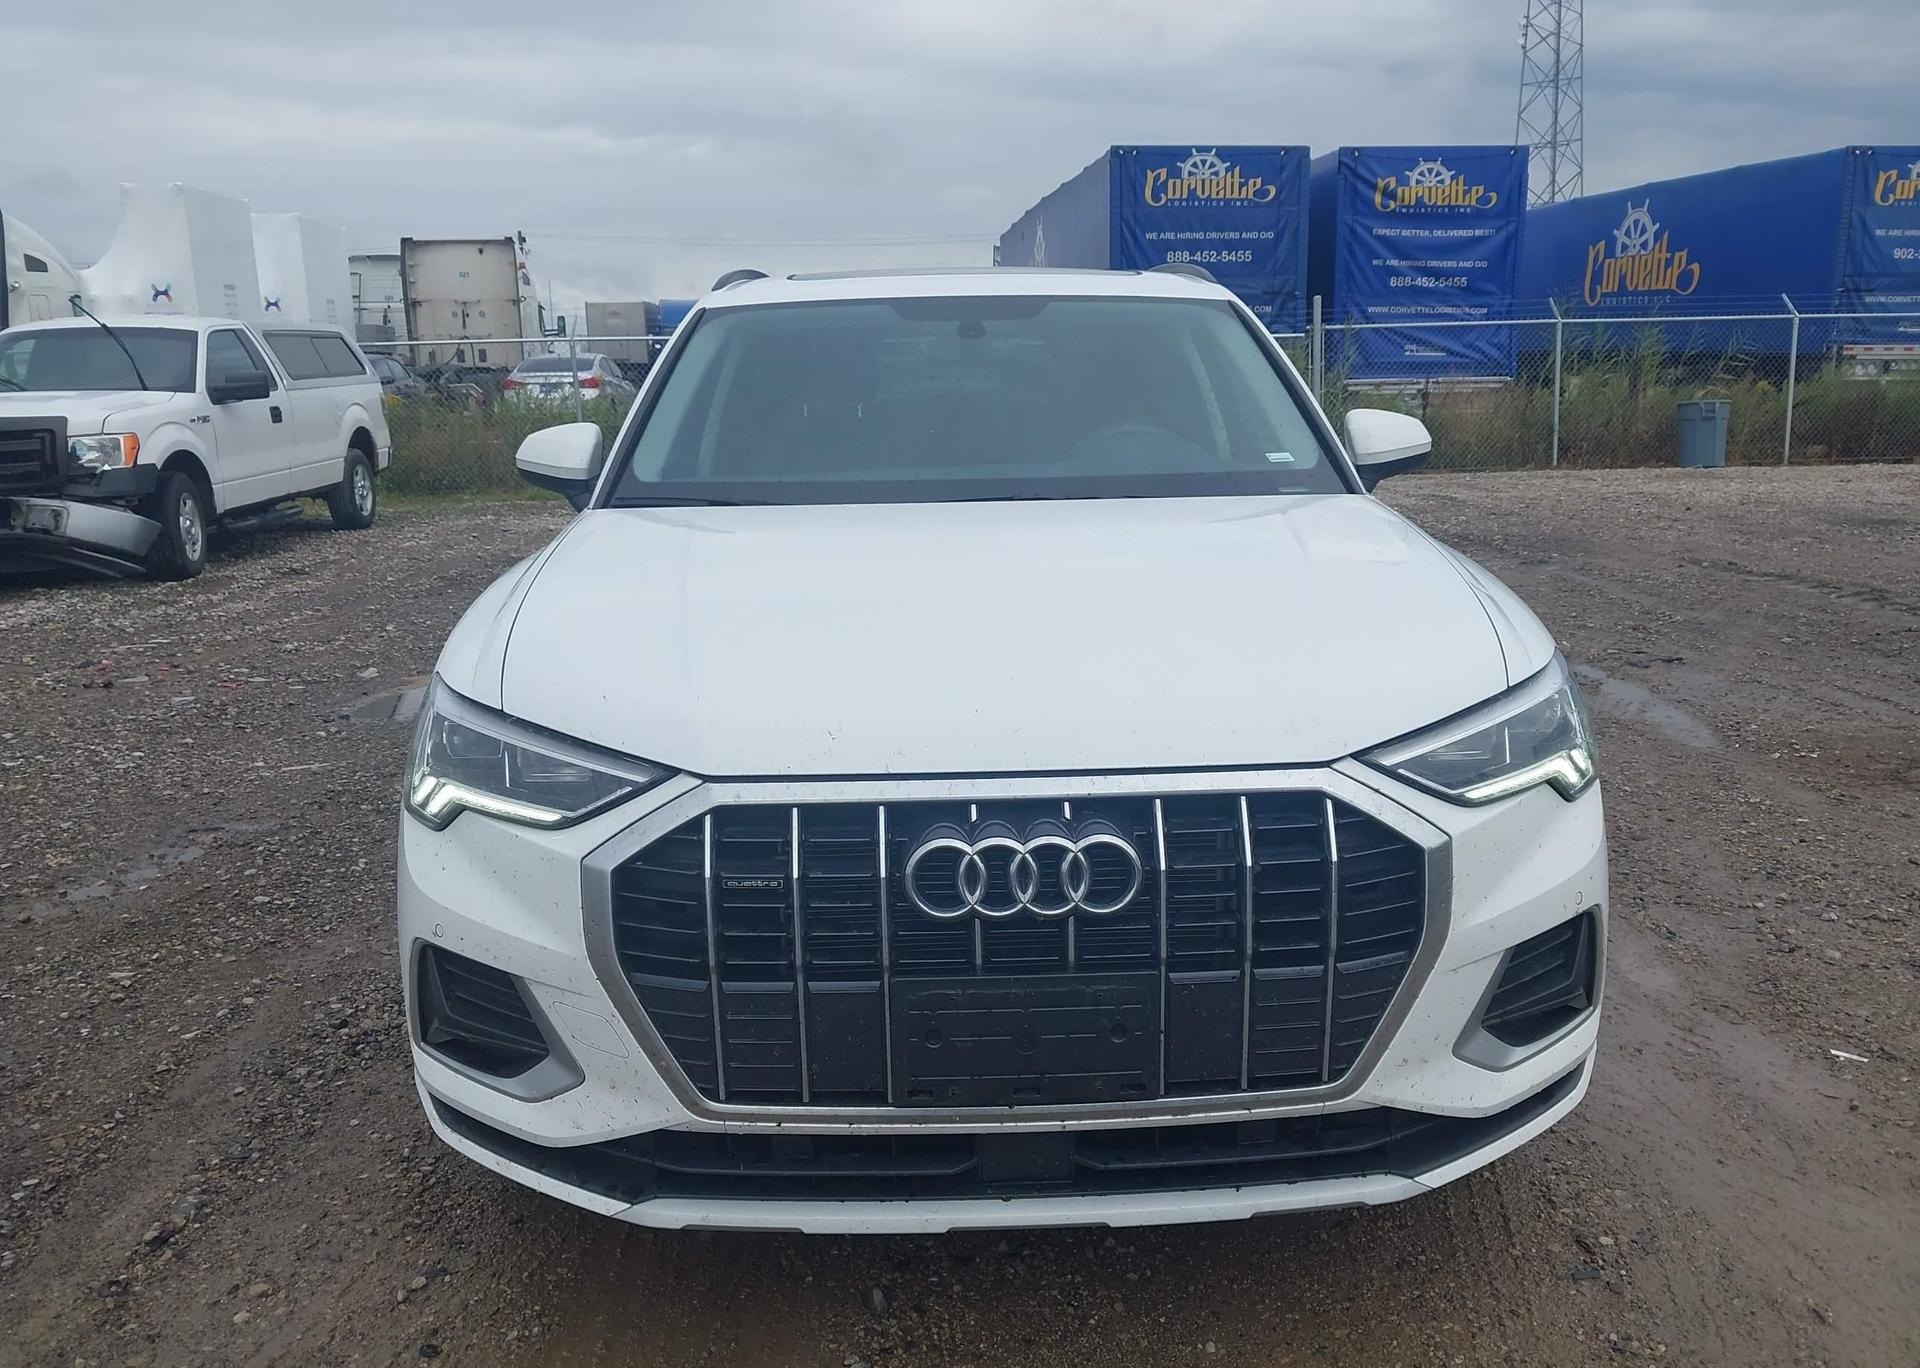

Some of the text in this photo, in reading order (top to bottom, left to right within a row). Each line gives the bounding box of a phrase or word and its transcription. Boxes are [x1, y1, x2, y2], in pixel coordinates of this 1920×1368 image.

[1144, 165, 1277, 207] Corvette
[1374, 174, 1498, 212] Corvette
[1372, 228, 1400, 236] EXPECT
[1433, 229, 1474, 237] DELIVERED
[1167, 250, 1253, 262] 888-452-5455
[1427, 260, 1457, 268] DRIVERS
[1458, 260, 1474, 268] AND
[1584, 229, 1701, 307] Corvette
[1390, 276, 1468, 287] 888-452-5455
